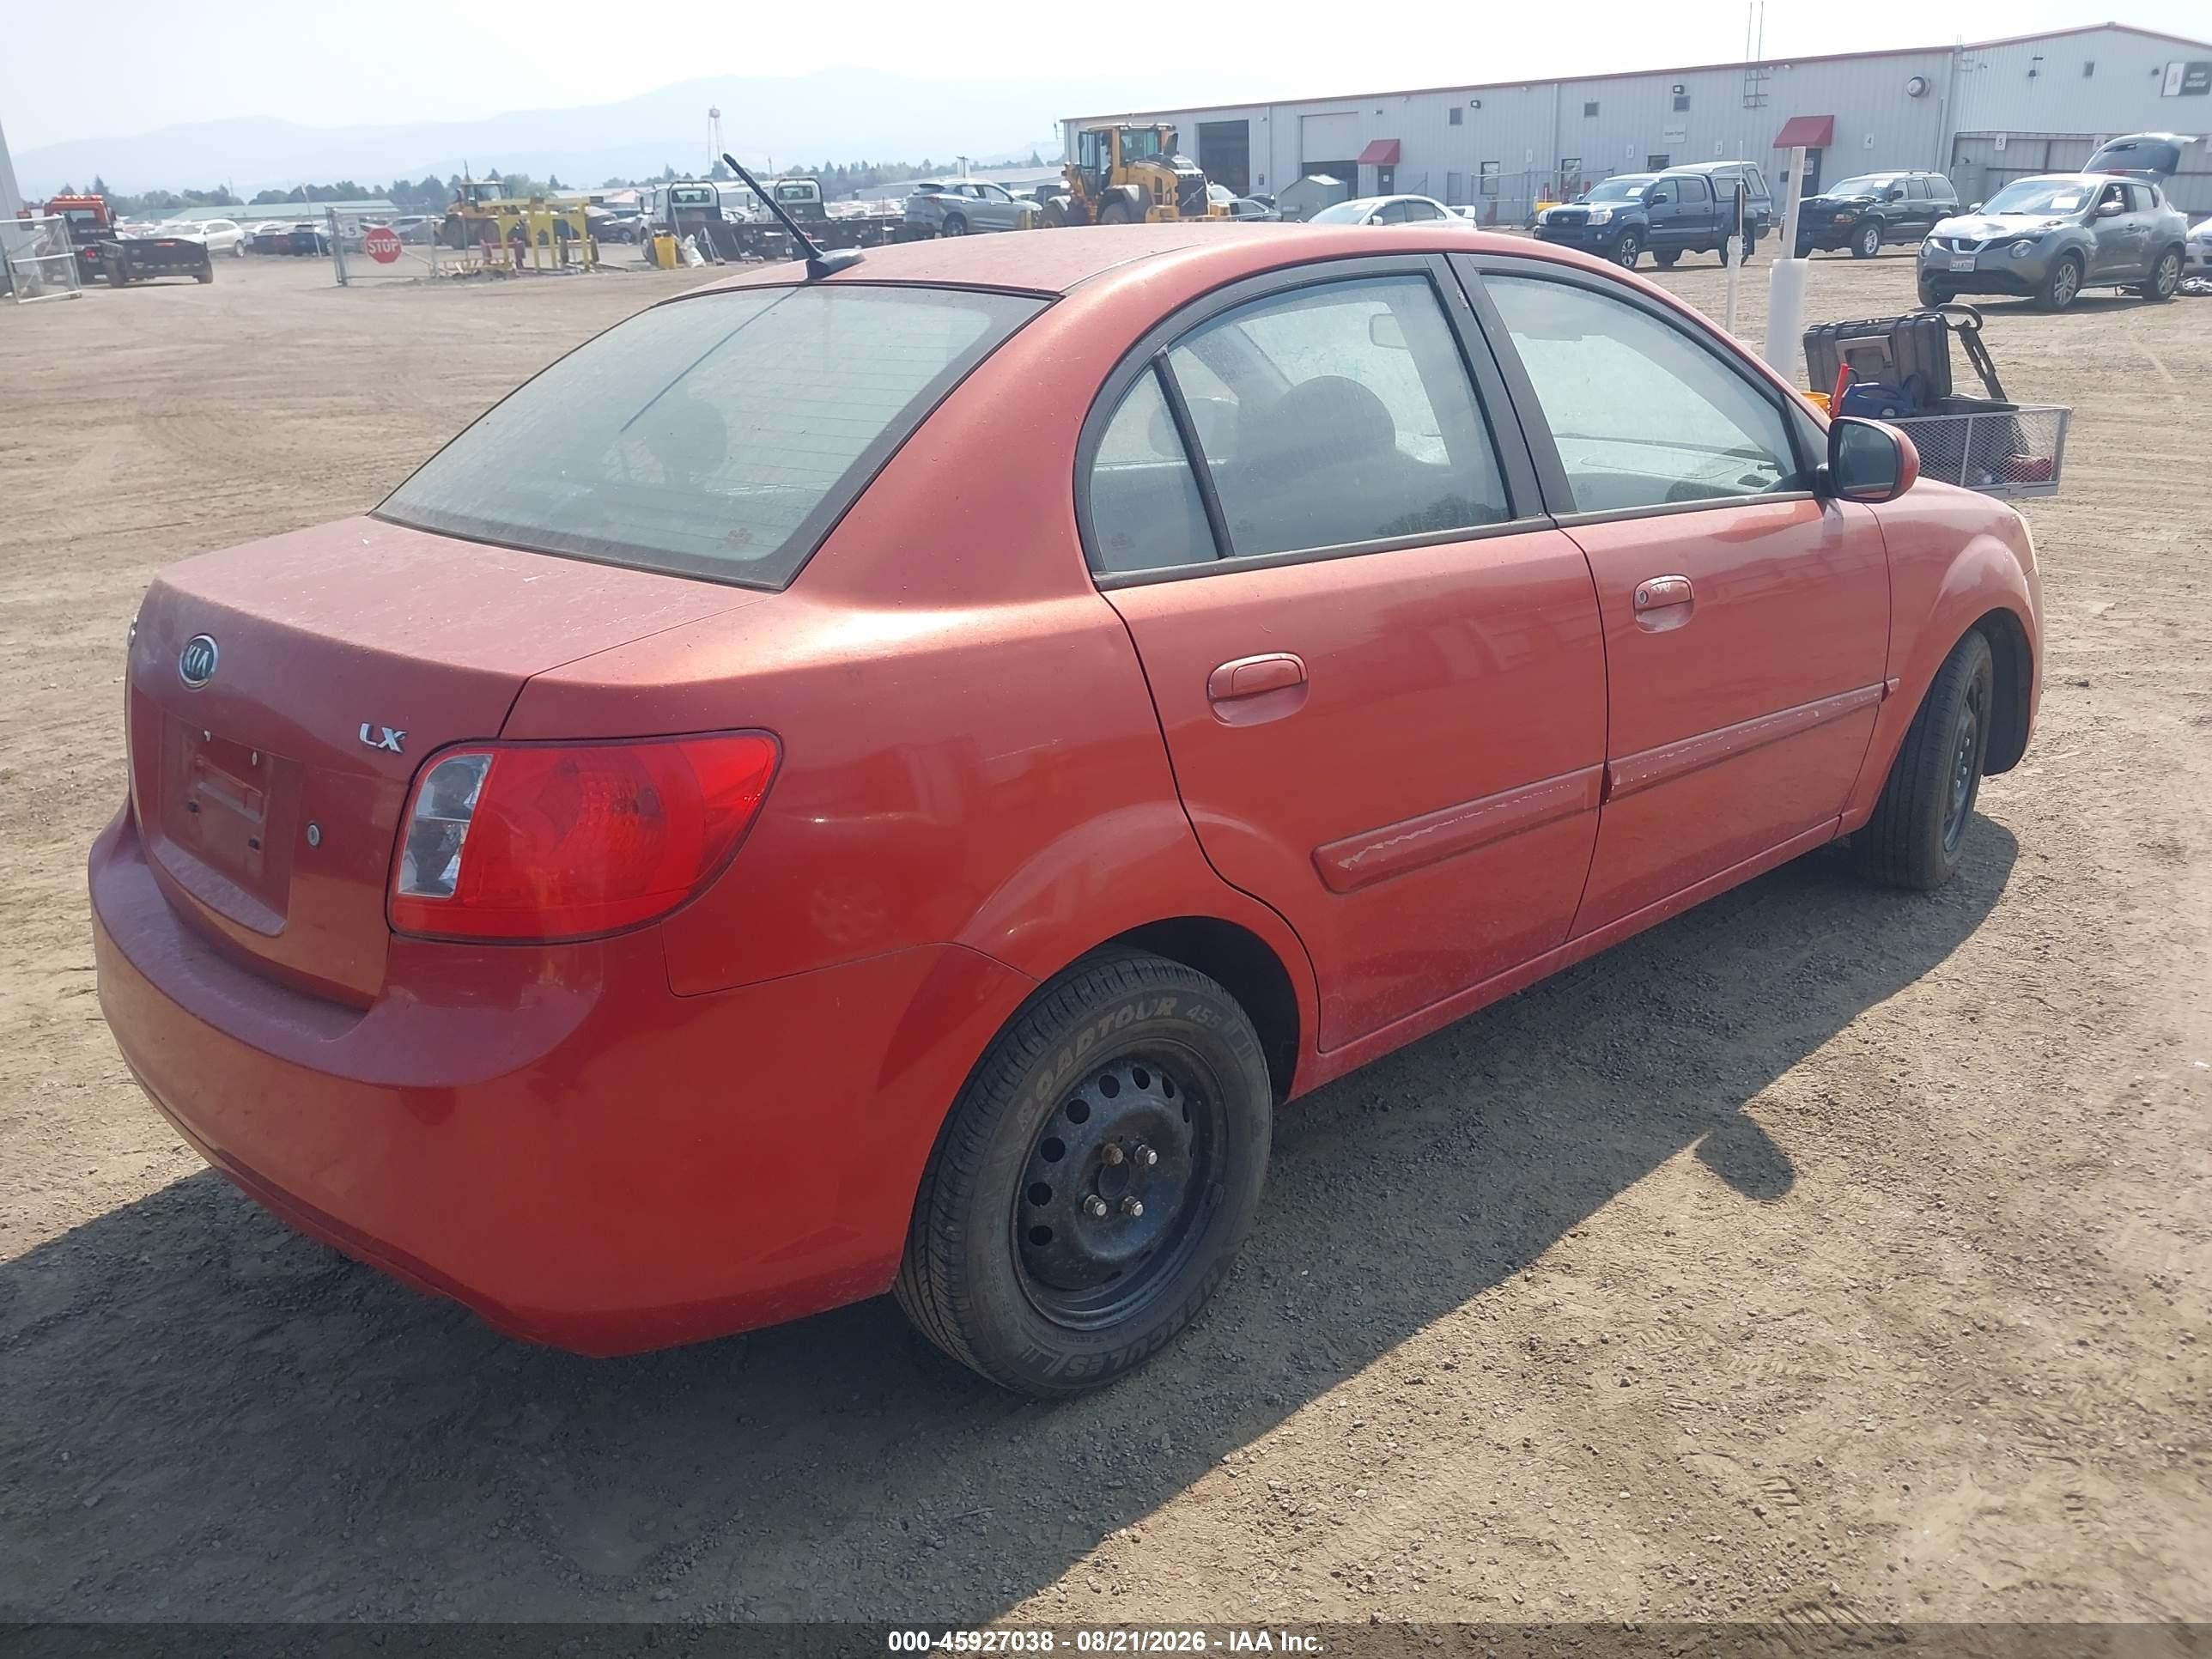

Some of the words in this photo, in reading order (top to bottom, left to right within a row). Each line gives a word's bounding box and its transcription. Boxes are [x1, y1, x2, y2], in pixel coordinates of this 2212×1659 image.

[368, 239, 398, 254] STOP
[183, 644, 210, 677] KIA
[359, 722, 407, 753] LX
[1016, 996, 1178, 1129] ROADTOUR
[1187, 1004, 1223, 1030] 455
